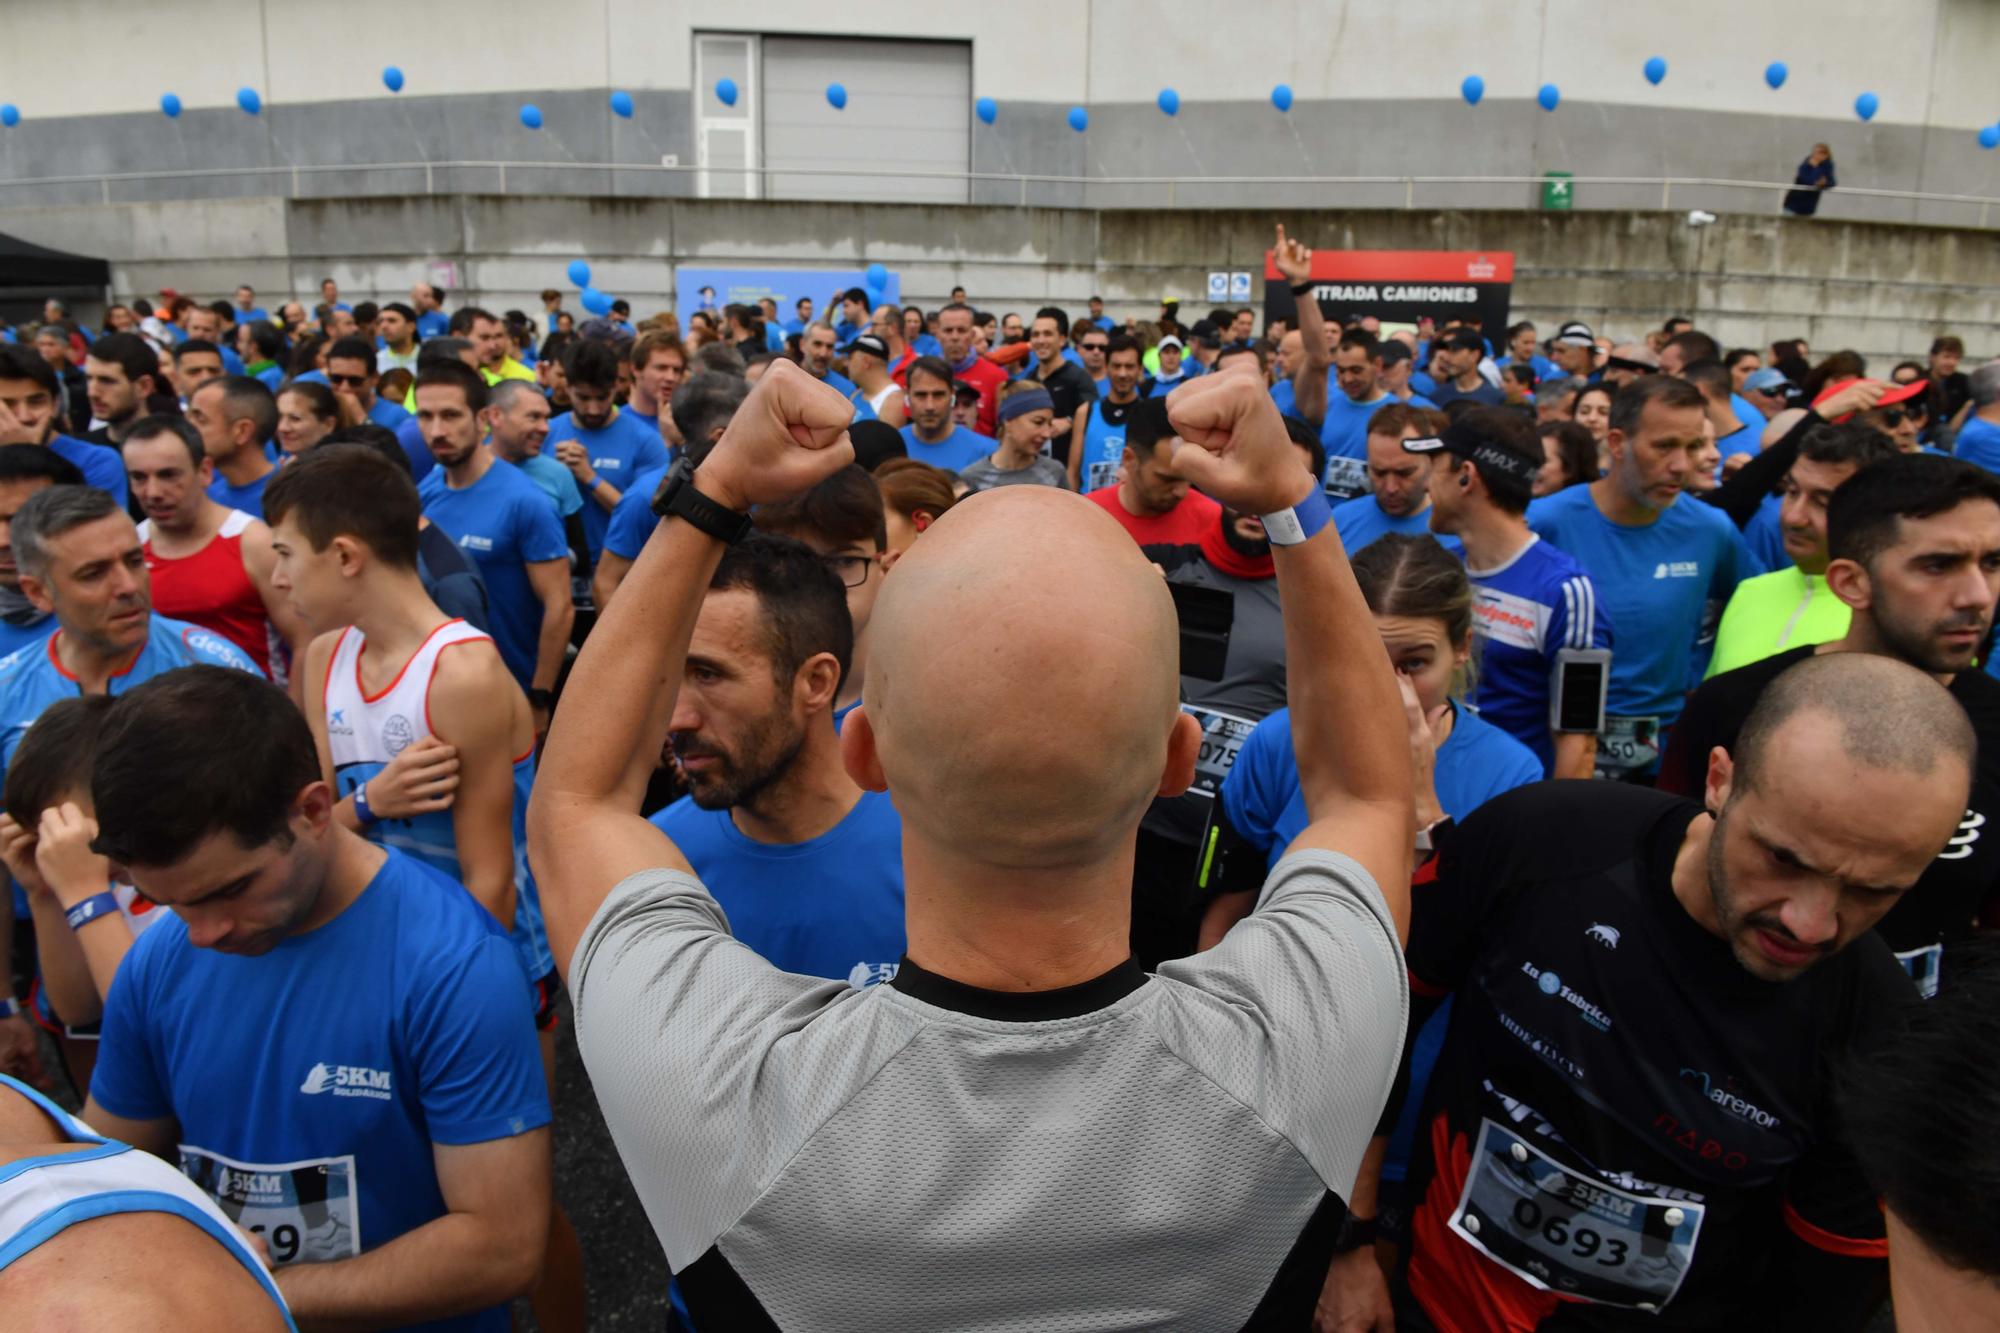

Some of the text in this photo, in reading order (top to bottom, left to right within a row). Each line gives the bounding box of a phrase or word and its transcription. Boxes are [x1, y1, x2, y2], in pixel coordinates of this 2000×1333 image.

[1312, 285, 1478, 302] NTRADA CAMIONES
[335, 1065, 391, 1090] 5KM
[232, 1173, 282, 1193] 5KM
[1573, 1182, 1636, 1217] 5KM
[1513, 1199, 1629, 1267] 0693
